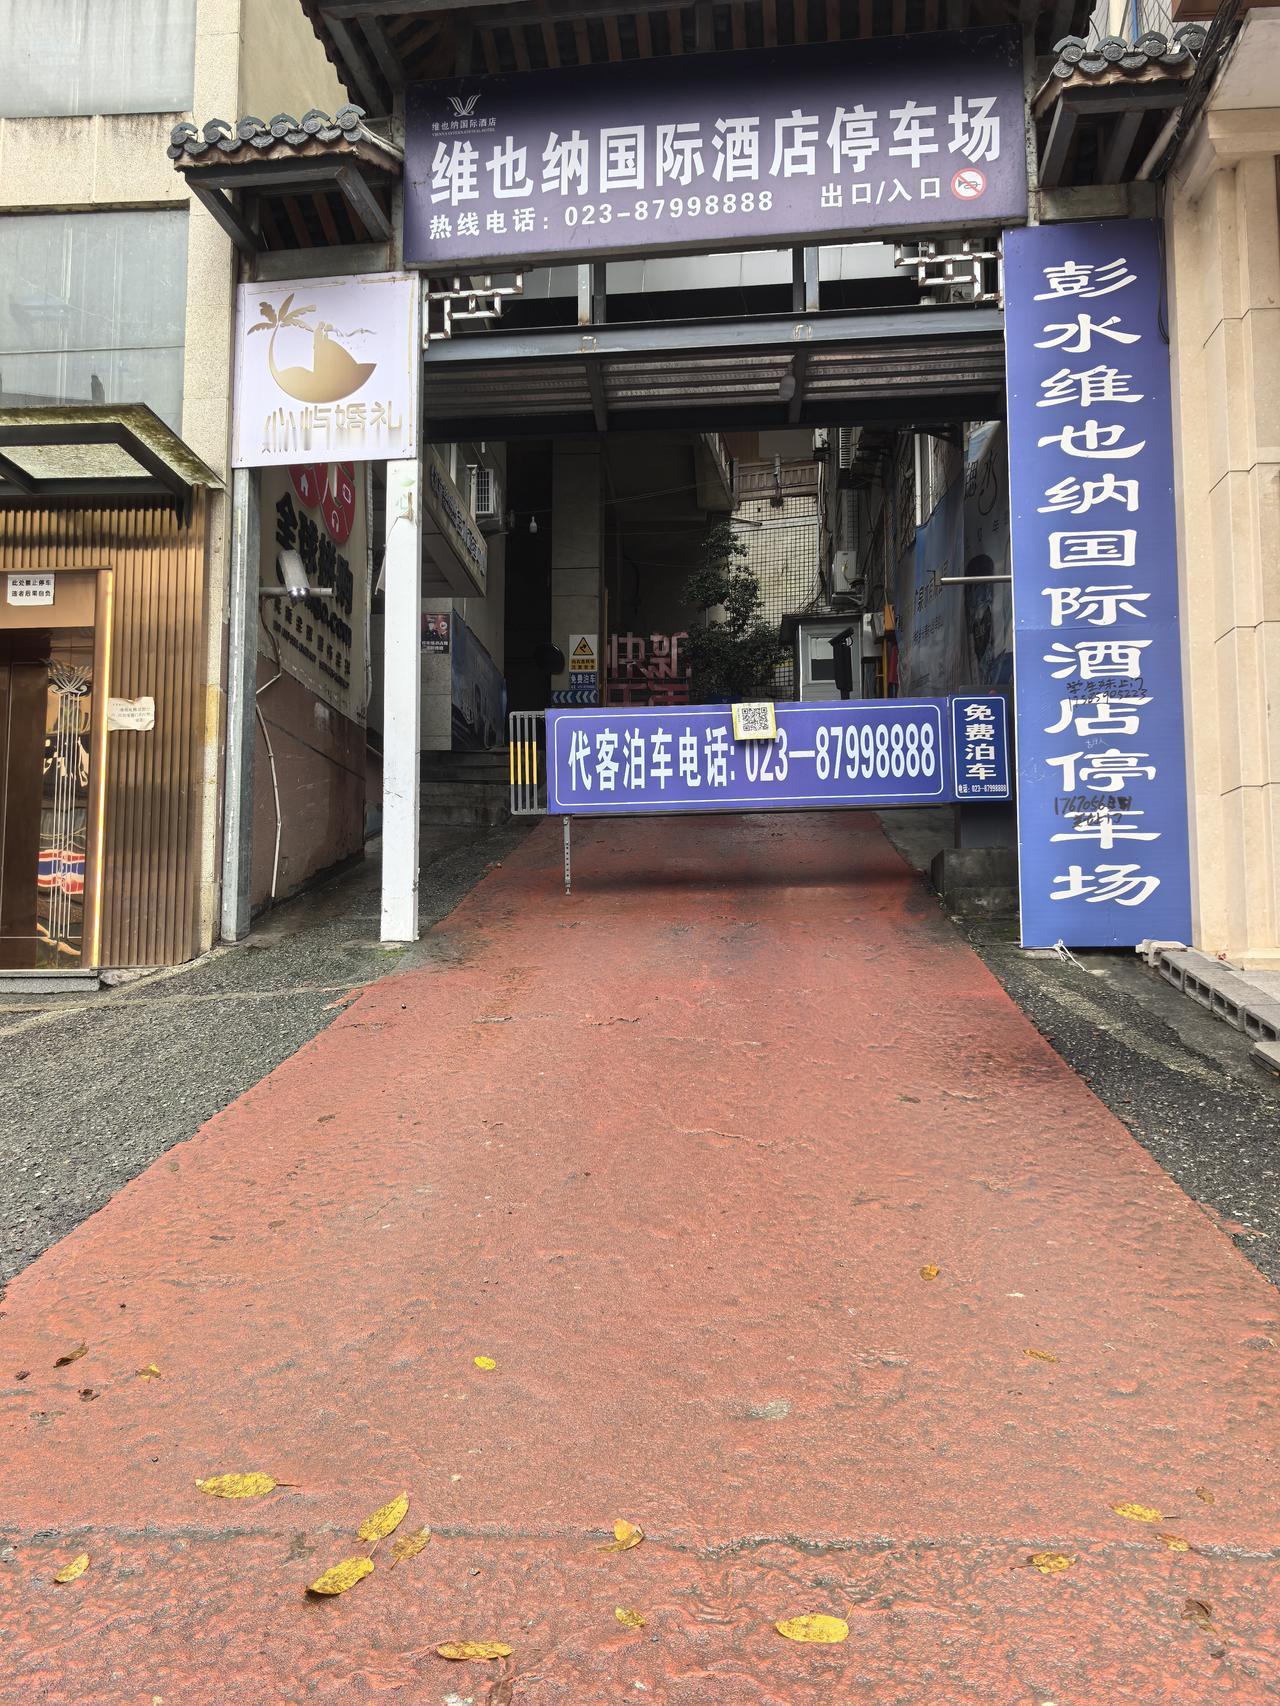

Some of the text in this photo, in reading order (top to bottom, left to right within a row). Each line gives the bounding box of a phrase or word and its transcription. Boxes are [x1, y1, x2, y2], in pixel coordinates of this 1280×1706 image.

[430, 94, 1001, 206] 维也纳国际酒店停车场
[432, 118, 496, 131] 维也纳国际酒店
[820, 177, 942, 208] 出口/入口
[1033, 257, 1162, 907] 彭水维也纳国际酒店停车场
[963, 703, 997, 781] 免费泊车
